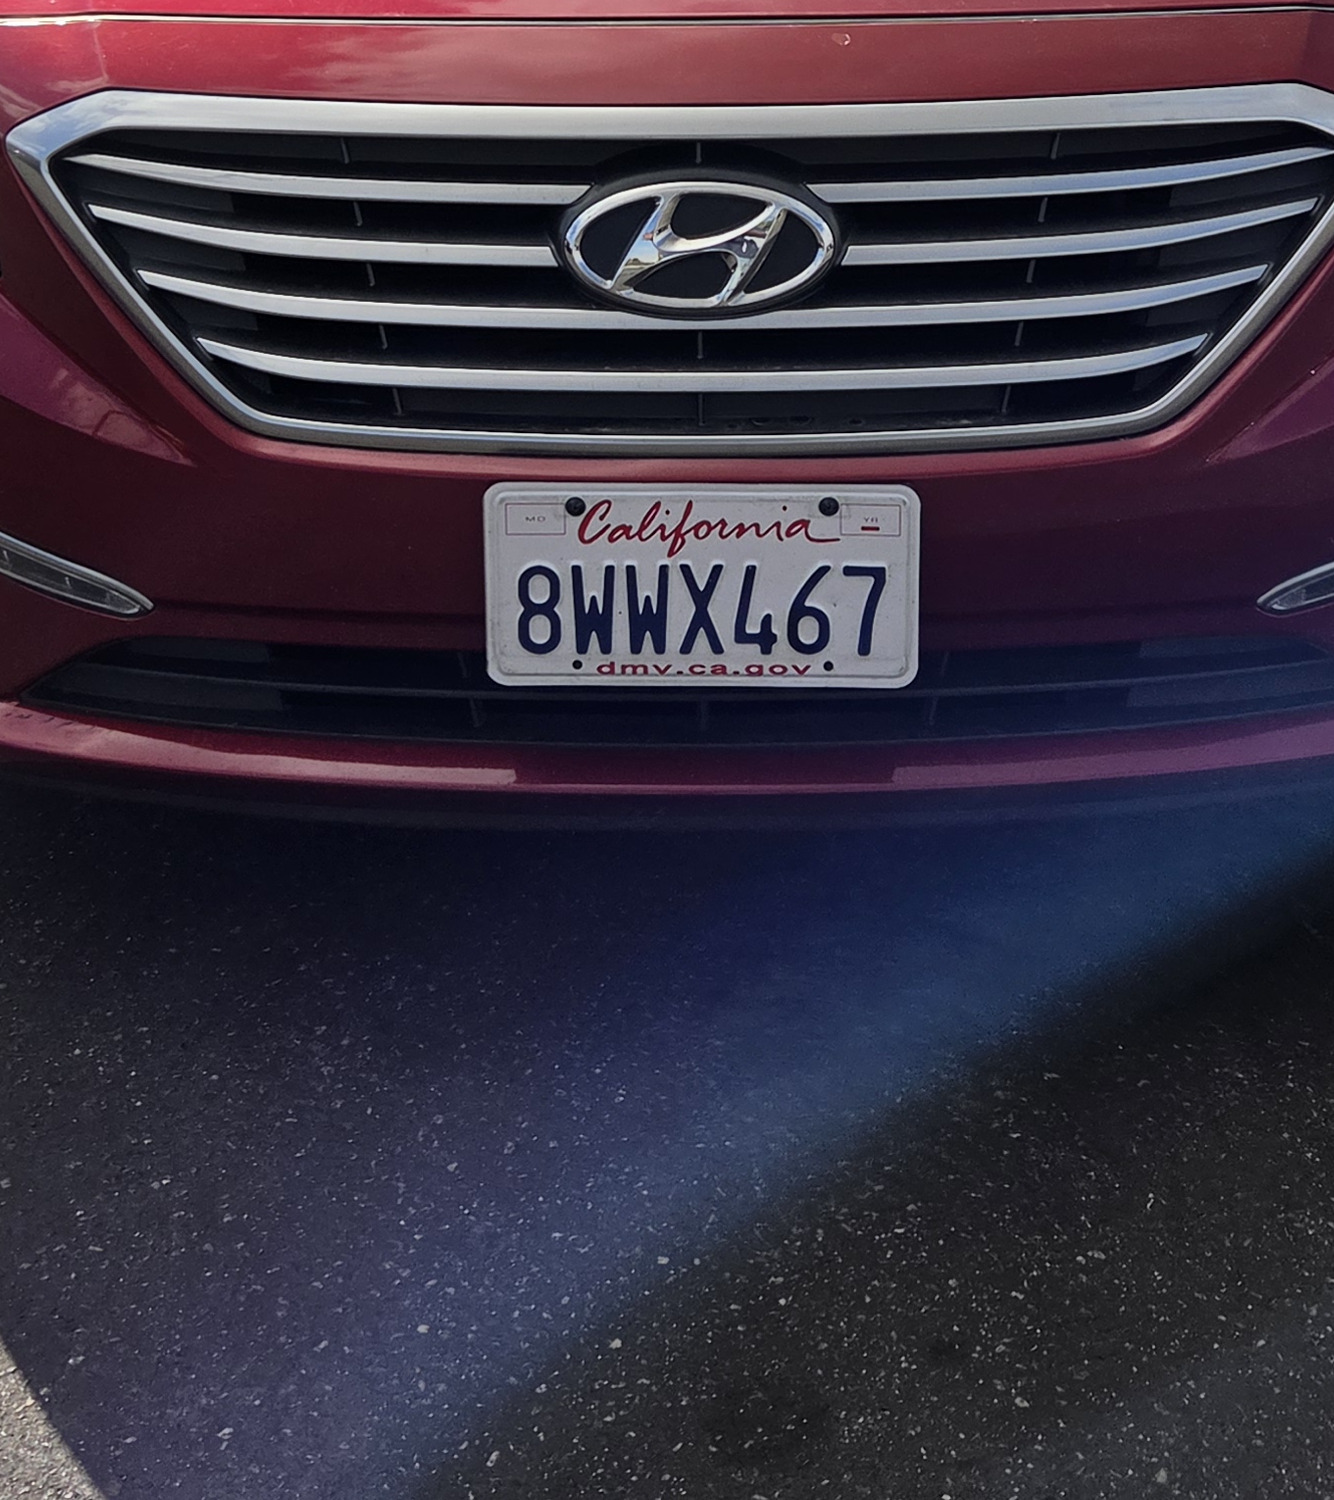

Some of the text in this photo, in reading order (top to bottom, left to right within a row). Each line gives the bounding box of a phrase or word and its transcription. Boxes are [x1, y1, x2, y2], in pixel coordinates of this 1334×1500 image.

[577, 499, 841, 558] California
[517, 563, 887, 656] 8WWX467
[595, 661, 812, 676] dmv.ca.gov
